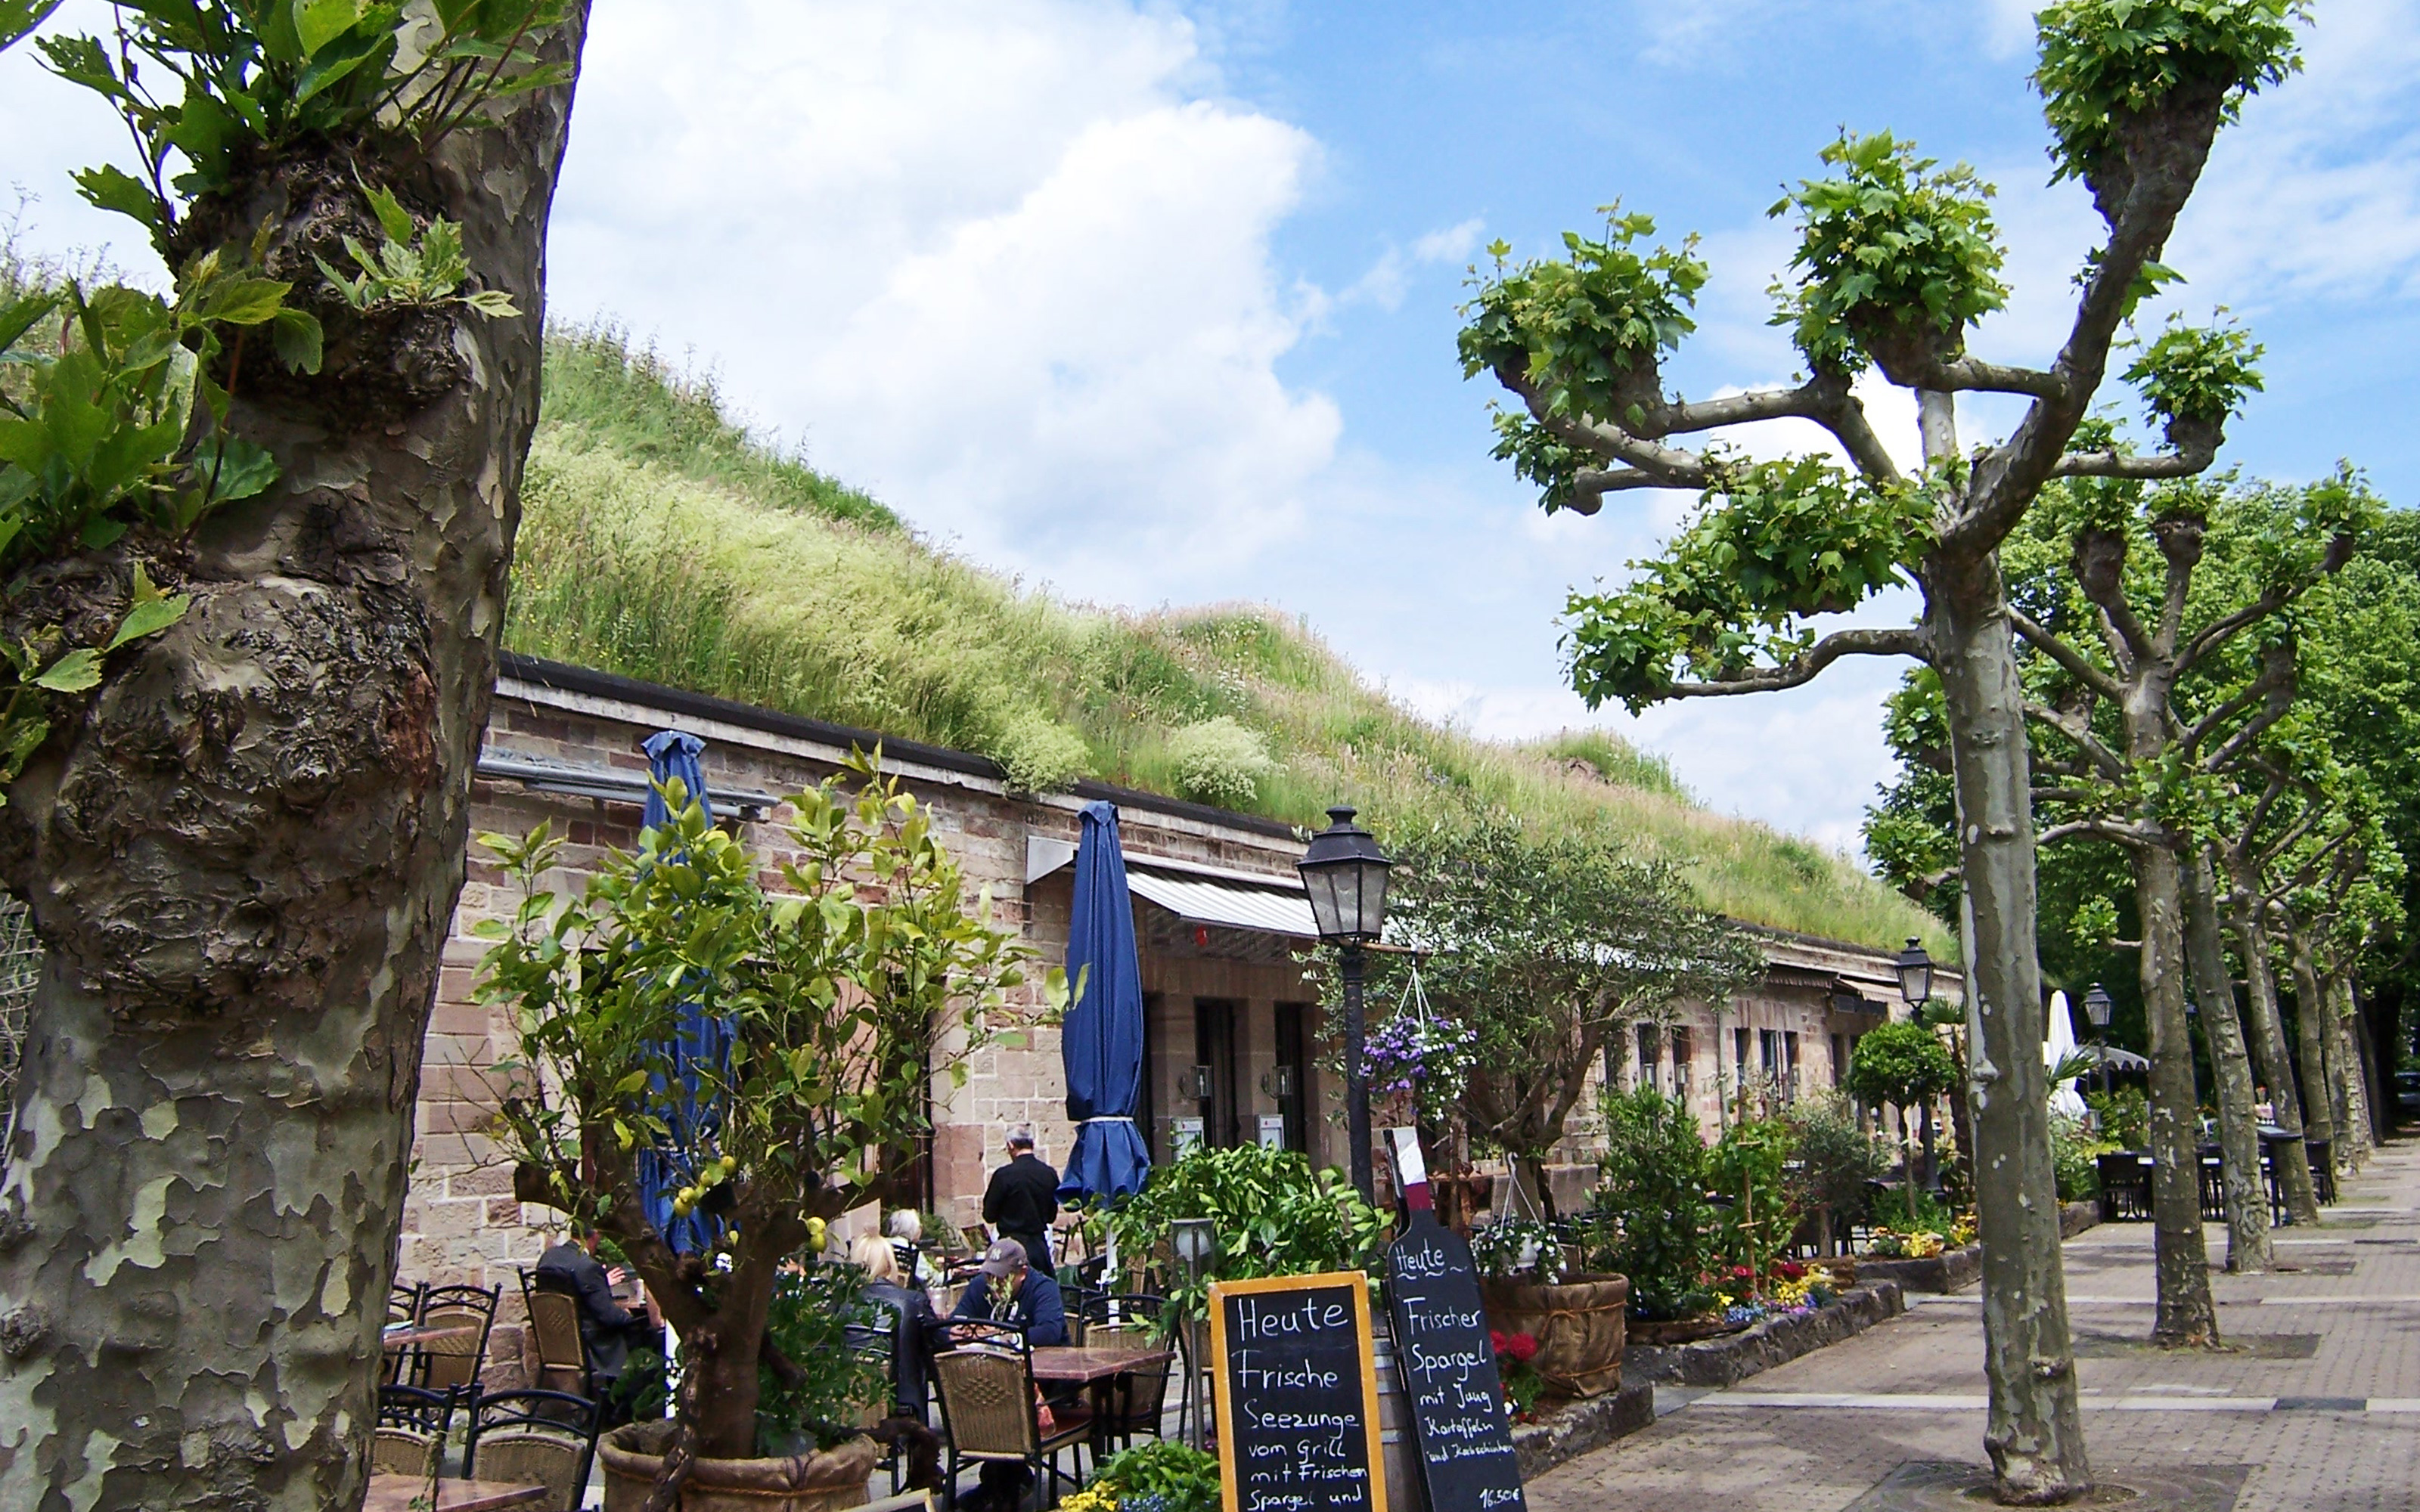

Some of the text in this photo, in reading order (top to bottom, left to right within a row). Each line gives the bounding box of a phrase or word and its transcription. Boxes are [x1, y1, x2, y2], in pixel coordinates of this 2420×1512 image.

[1395, 1238, 1444, 1272] Heute
[1238, 1298, 1348, 1341] Heute
[1403, 1297, 1481, 1337] Frischer
[1231, 1349, 1339, 1389] Frische
[1412, 1339, 1487, 1383] Spargel
[1419, 1386, 1444, 1405] mit
[1244, 1399, 1360, 1439] Seezunge
[1424, 1416, 1494, 1439] Kartoffeln
[1249, 1444, 1287, 1458] vom
[1426, 1445, 1449, 1463] und
[1251, 1464, 1292, 1483] mit
[1247, 1483, 1362, 1511] Spargel und
